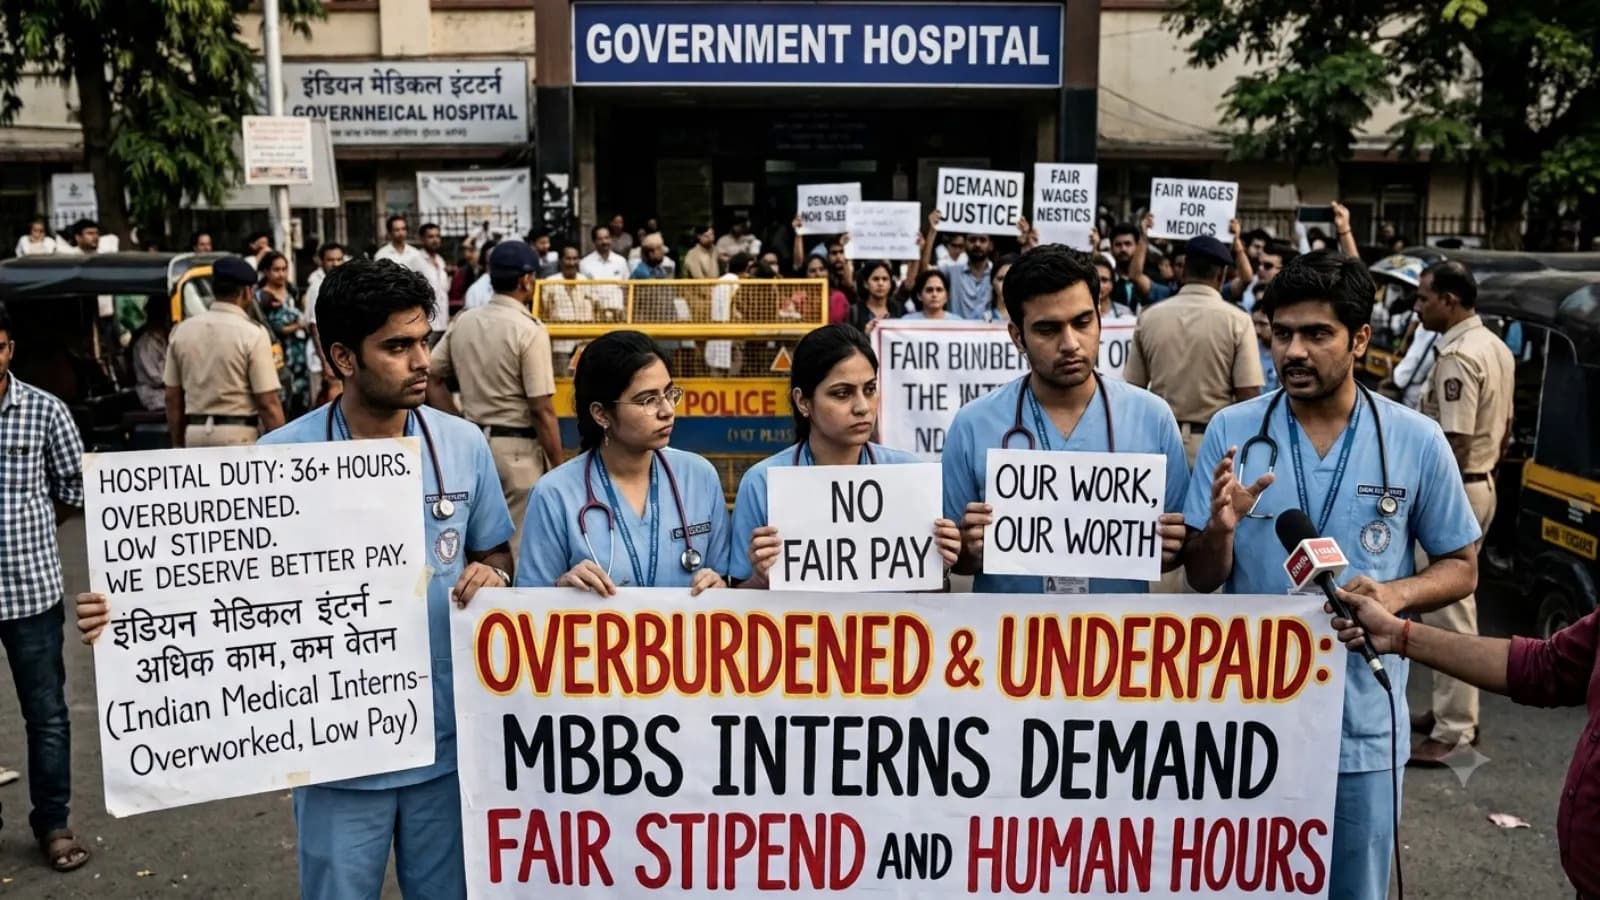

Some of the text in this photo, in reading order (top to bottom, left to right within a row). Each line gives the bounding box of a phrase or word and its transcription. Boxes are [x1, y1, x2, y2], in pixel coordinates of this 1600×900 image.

[586, 23, 1050, 65] GOVERNMENT HOSPITAL
[433, 104, 518, 120] HOSPITAL
[944, 175, 1018, 198] DEMAND
[1051, 170, 1080, 184] FAIR
[1155, 183, 1234, 200] FAIR WAGES
[941, 202, 1017, 226] JUSTICE
[1037, 208, 1091, 222] NESTICS
[1042, 189, 1088, 204] WAGES
[1180, 203, 1206, 217] FOR
[1166, 220, 1216, 237] MEDICS
[891, 342, 939, 370] FAIR
[684, 390, 776, 416] POLICE
[903, 383, 948, 411] THE
[100, 453, 411, 493] HOSPITAL DUTY: 36+ HOURS.
[995, 464, 1158, 508] OUR WORK,
[101, 496, 300, 530] OVERBURDENED.
[831, 479, 883, 523] NO
[104, 527, 277, 563] LOW STIPEND.
[994, 516, 1156, 557] OUR WORTH
[105, 569, 143, 594] WE
[156, 558, 259, 589] DESERVE
[271, 549, 355, 578] BETTER
[365, 543, 407, 569] PAY.
[784, 536, 932, 581] FAIR PAY
[111, 608, 197, 649] इंडियन
[210, 597, 302, 633] मेडिकल
[316, 583, 369, 626] इंटर्न
[135, 622, 397, 683] अधिक काम, कम वेतन
[475, 609, 1333, 702] OVERBURDENED & UNDERPAID:
[106, 697, 211, 741] (Indian
[222, 675, 319, 716] Medical
[130, 699, 418, 775] Overworked, Low Pay)
[502, 713, 1279, 800] MBBS INTERNS DEMAND
[487, 808, 1327, 895] FAIR STIPEND AND HUMAN HOURS
